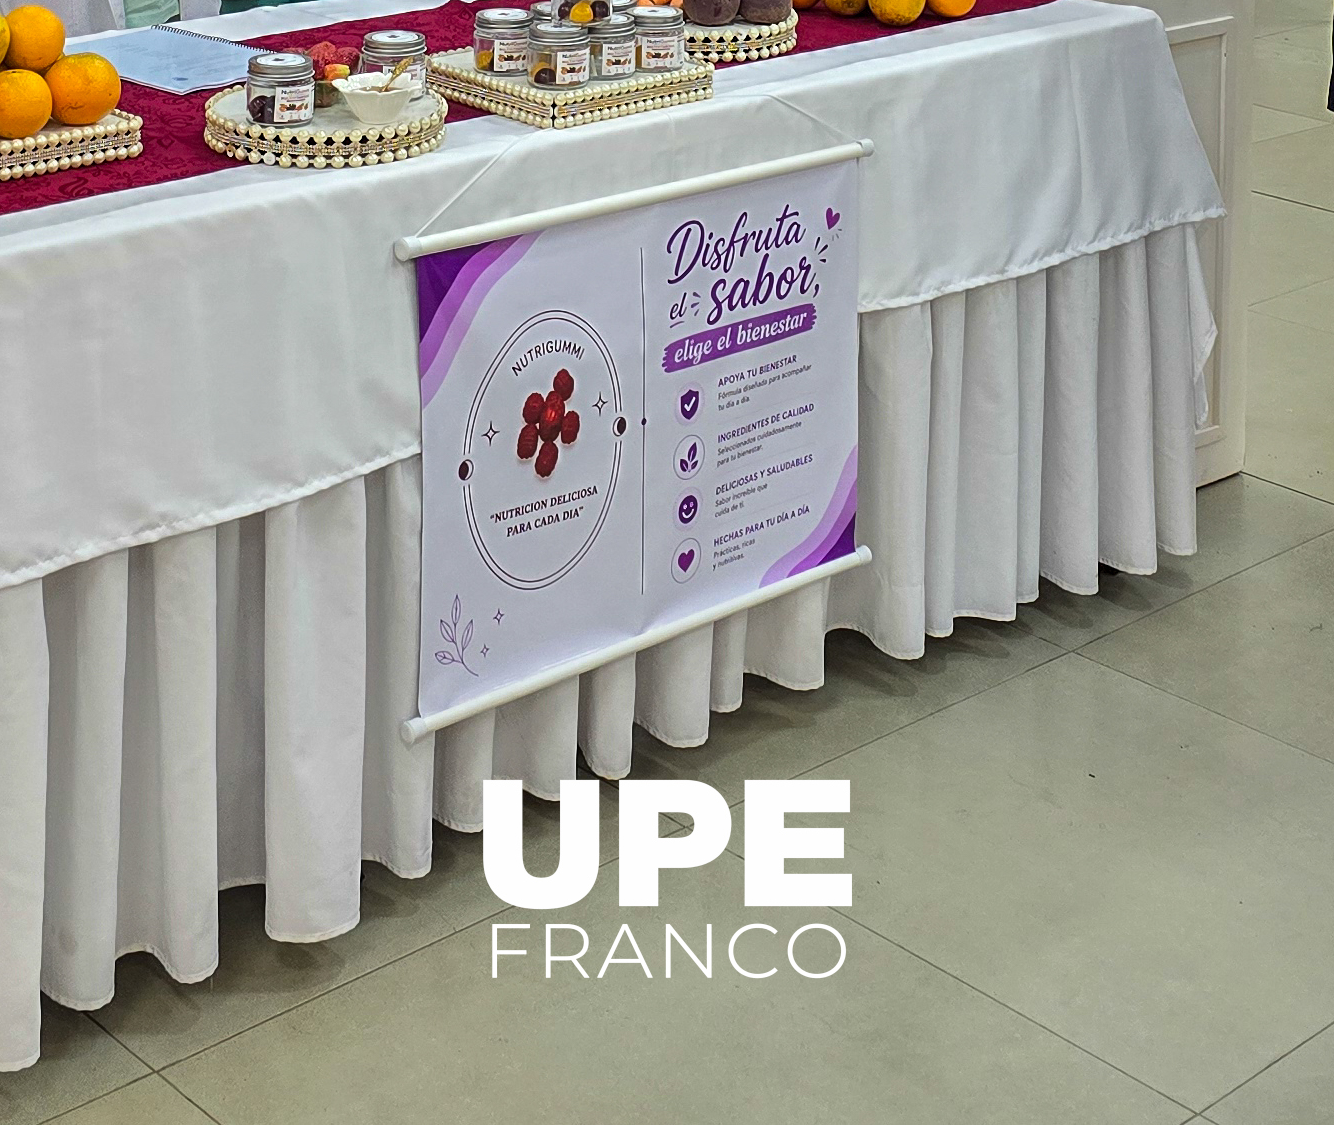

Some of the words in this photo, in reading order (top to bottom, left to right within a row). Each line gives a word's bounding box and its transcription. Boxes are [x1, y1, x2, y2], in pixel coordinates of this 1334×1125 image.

[667, 204, 807, 284] Disfruta
[670, 292, 688, 320] el
[707, 253, 819, 325] sabor,
[674, 339, 713, 364] elige
[717, 328, 732, 350] el
[737, 311, 807, 345] bienestar
[511, 339, 585, 376] NUTRIGUMMI
[718, 372, 745, 387] APOYA
[747, 368, 757, 379] TU
[759, 355, 797, 374] BIENESTAR
[768, 374, 780, 385] para
[717, 418, 769, 444] INGREDIENTES
[771, 414, 780, 424] DE
[782, 403, 815, 420] CALIDAD
[717, 436, 756, 456] Seleccionados
[757, 421, 802, 441] cuidadosamente
[716, 472, 758, 495] DELICIOSAS
[760, 469, 765, 478] Y
[767, 454, 813, 476] SALUDABLES
[717, 457, 729, 468] para
[550, 485, 598, 507] DELICIOSA
[715, 496, 731, 507] Sabor
[757, 483, 768, 492] que
[506, 522, 532, 537] PARA
[534, 513, 560, 528] CADA
[713, 529, 743, 547] HECHAS
[745, 522, 764, 535] PARA
[766, 517, 775, 527] TU
[777, 512, 789, 524] DÍA
[797, 504, 810, 516] DÍA
[715, 507, 729, 517] cuida
[712, 563, 716, 571] y
